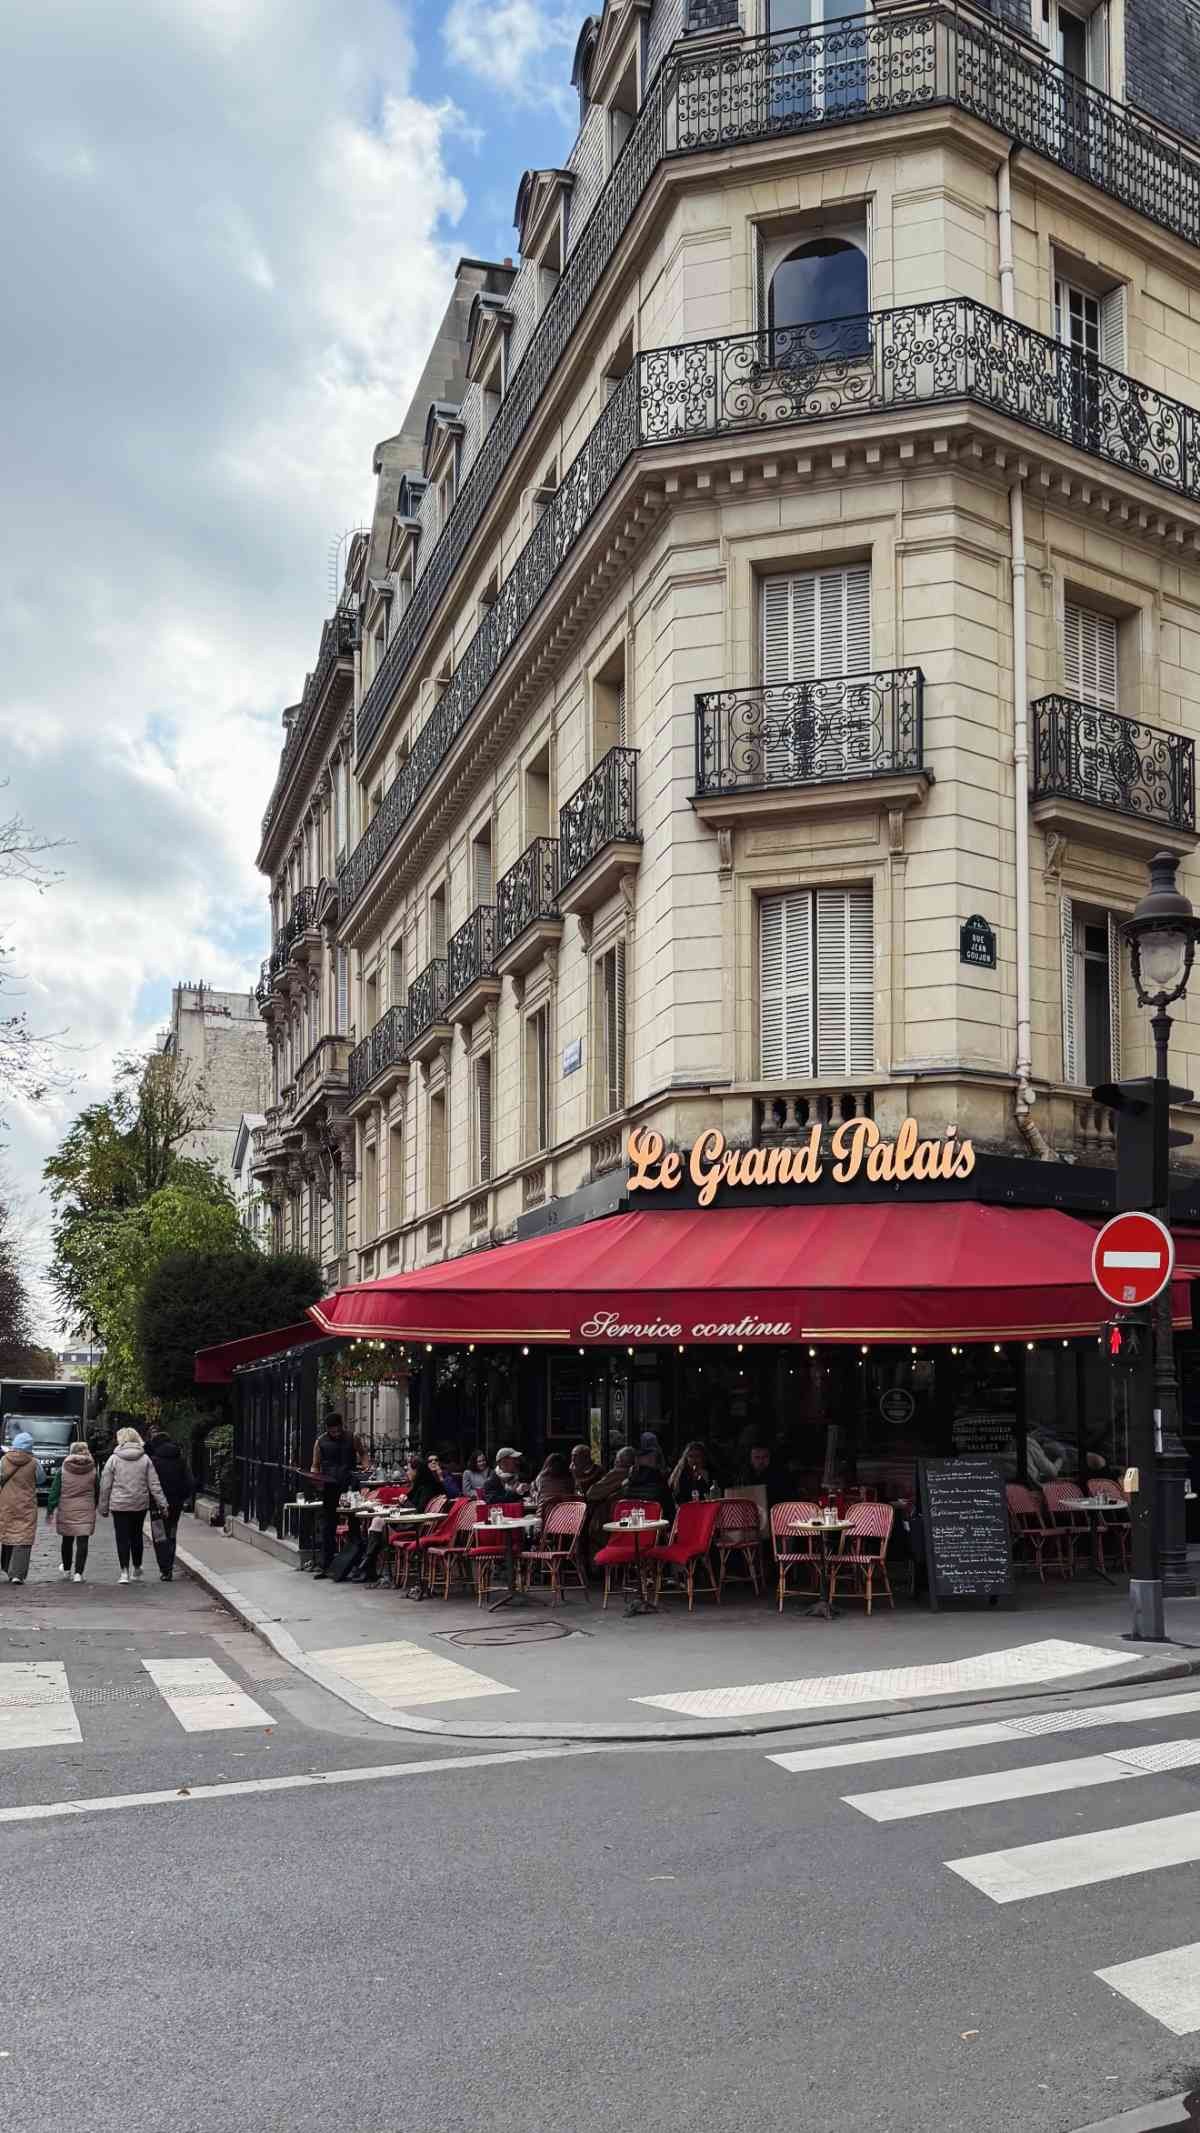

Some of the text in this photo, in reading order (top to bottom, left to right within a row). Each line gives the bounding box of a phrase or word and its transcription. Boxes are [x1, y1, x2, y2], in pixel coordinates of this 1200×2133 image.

[972, 934, 985, 944] RUE
[970, 943, 986, 952] JEAN
[966, 951, 991, 962] GOUJON
[626, 1117, 976, 1206] Le Grand Palais
[580, 1311, 792, 1338] Service continu
